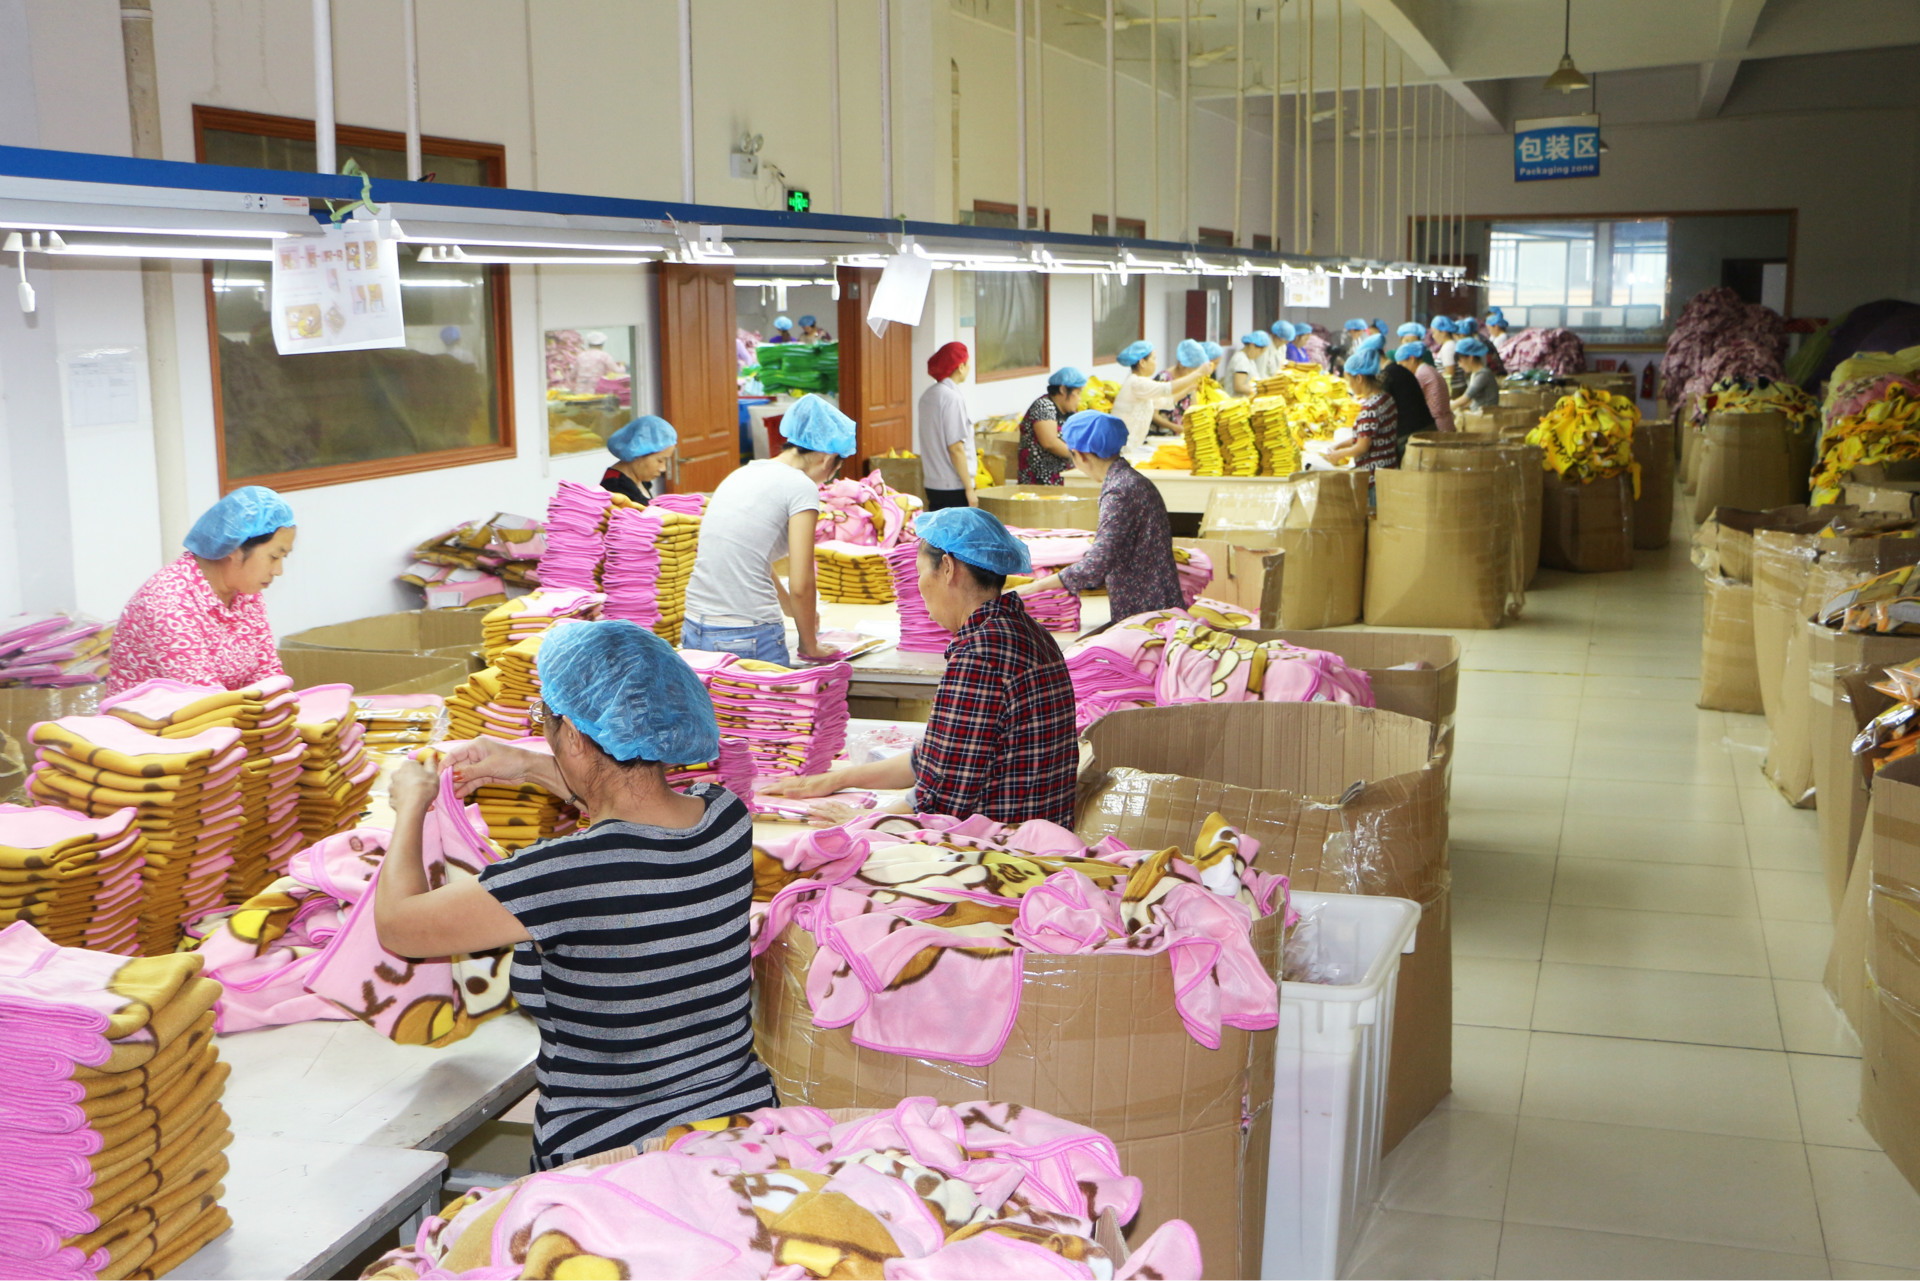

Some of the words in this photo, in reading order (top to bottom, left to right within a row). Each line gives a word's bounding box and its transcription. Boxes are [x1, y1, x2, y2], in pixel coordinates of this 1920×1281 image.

[1518, 132, 1597, 163] 包装区
[1519, 165, 1569, 176] Packaging
[1571, 164, 1595, 173] zone
